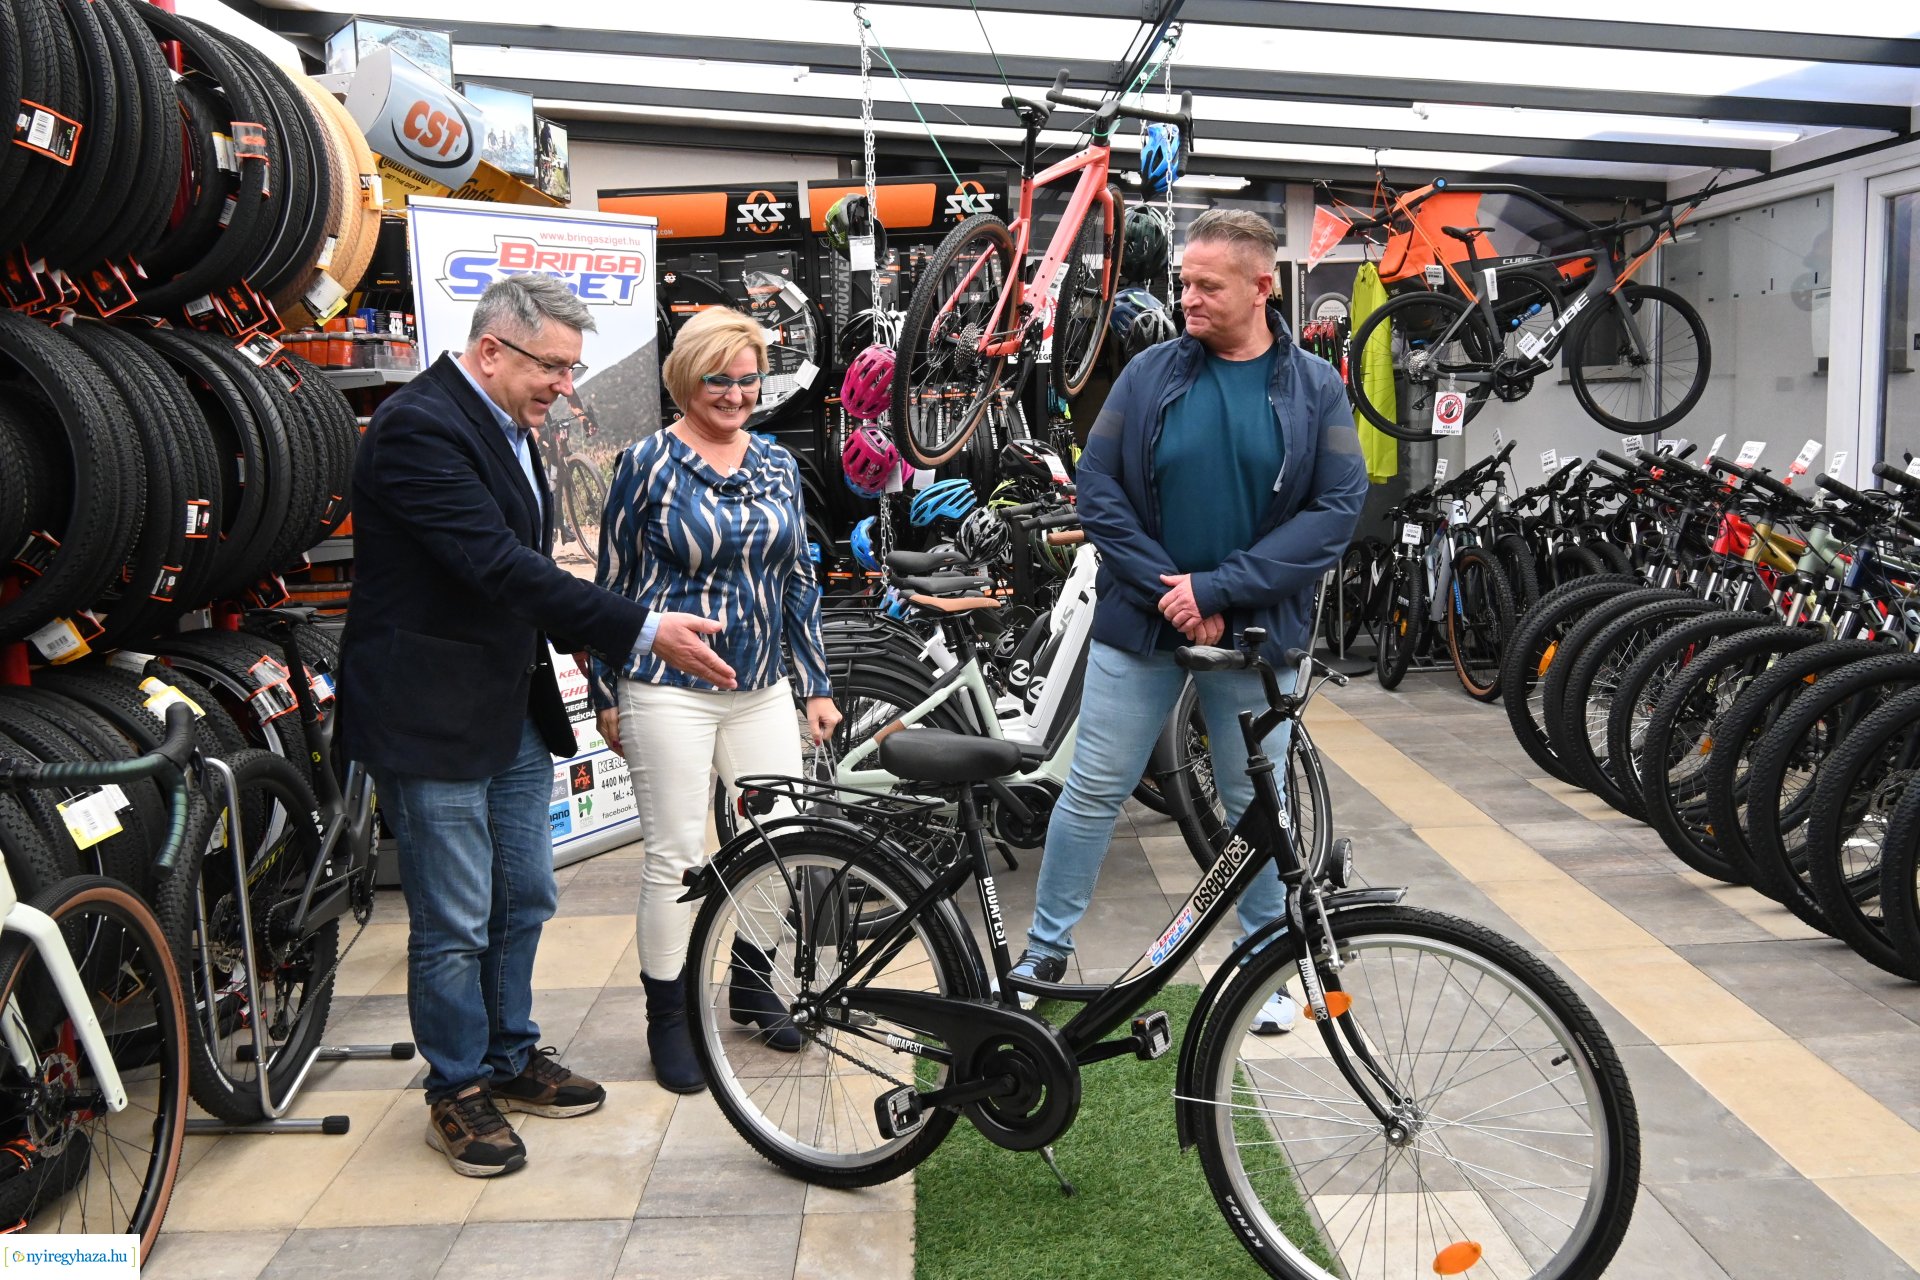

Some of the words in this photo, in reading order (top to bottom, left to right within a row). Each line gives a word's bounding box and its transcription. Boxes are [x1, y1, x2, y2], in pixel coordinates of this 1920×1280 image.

[403, 99, 463, 158] CST
[737, 202, 786, 223] SKS
[945, 194, 995, 214] SKS
[540, 231, 641, 247] www.bringasziget.hu
[736, 224, 791, 233] GERMANY
[1502, 256, 1535, 265] CUBE
[1540, 292, 1591, 349] CUBE
[601, 776, 617, 790] 4400
[1151, 913, 1193, 966] SZIGET
[1299, 957, 1323, 1005] BUDAPEST
[887, 1033, 924, 1054] BUDAPEST
[1225, 1194, 1264, 1248] KENDA
